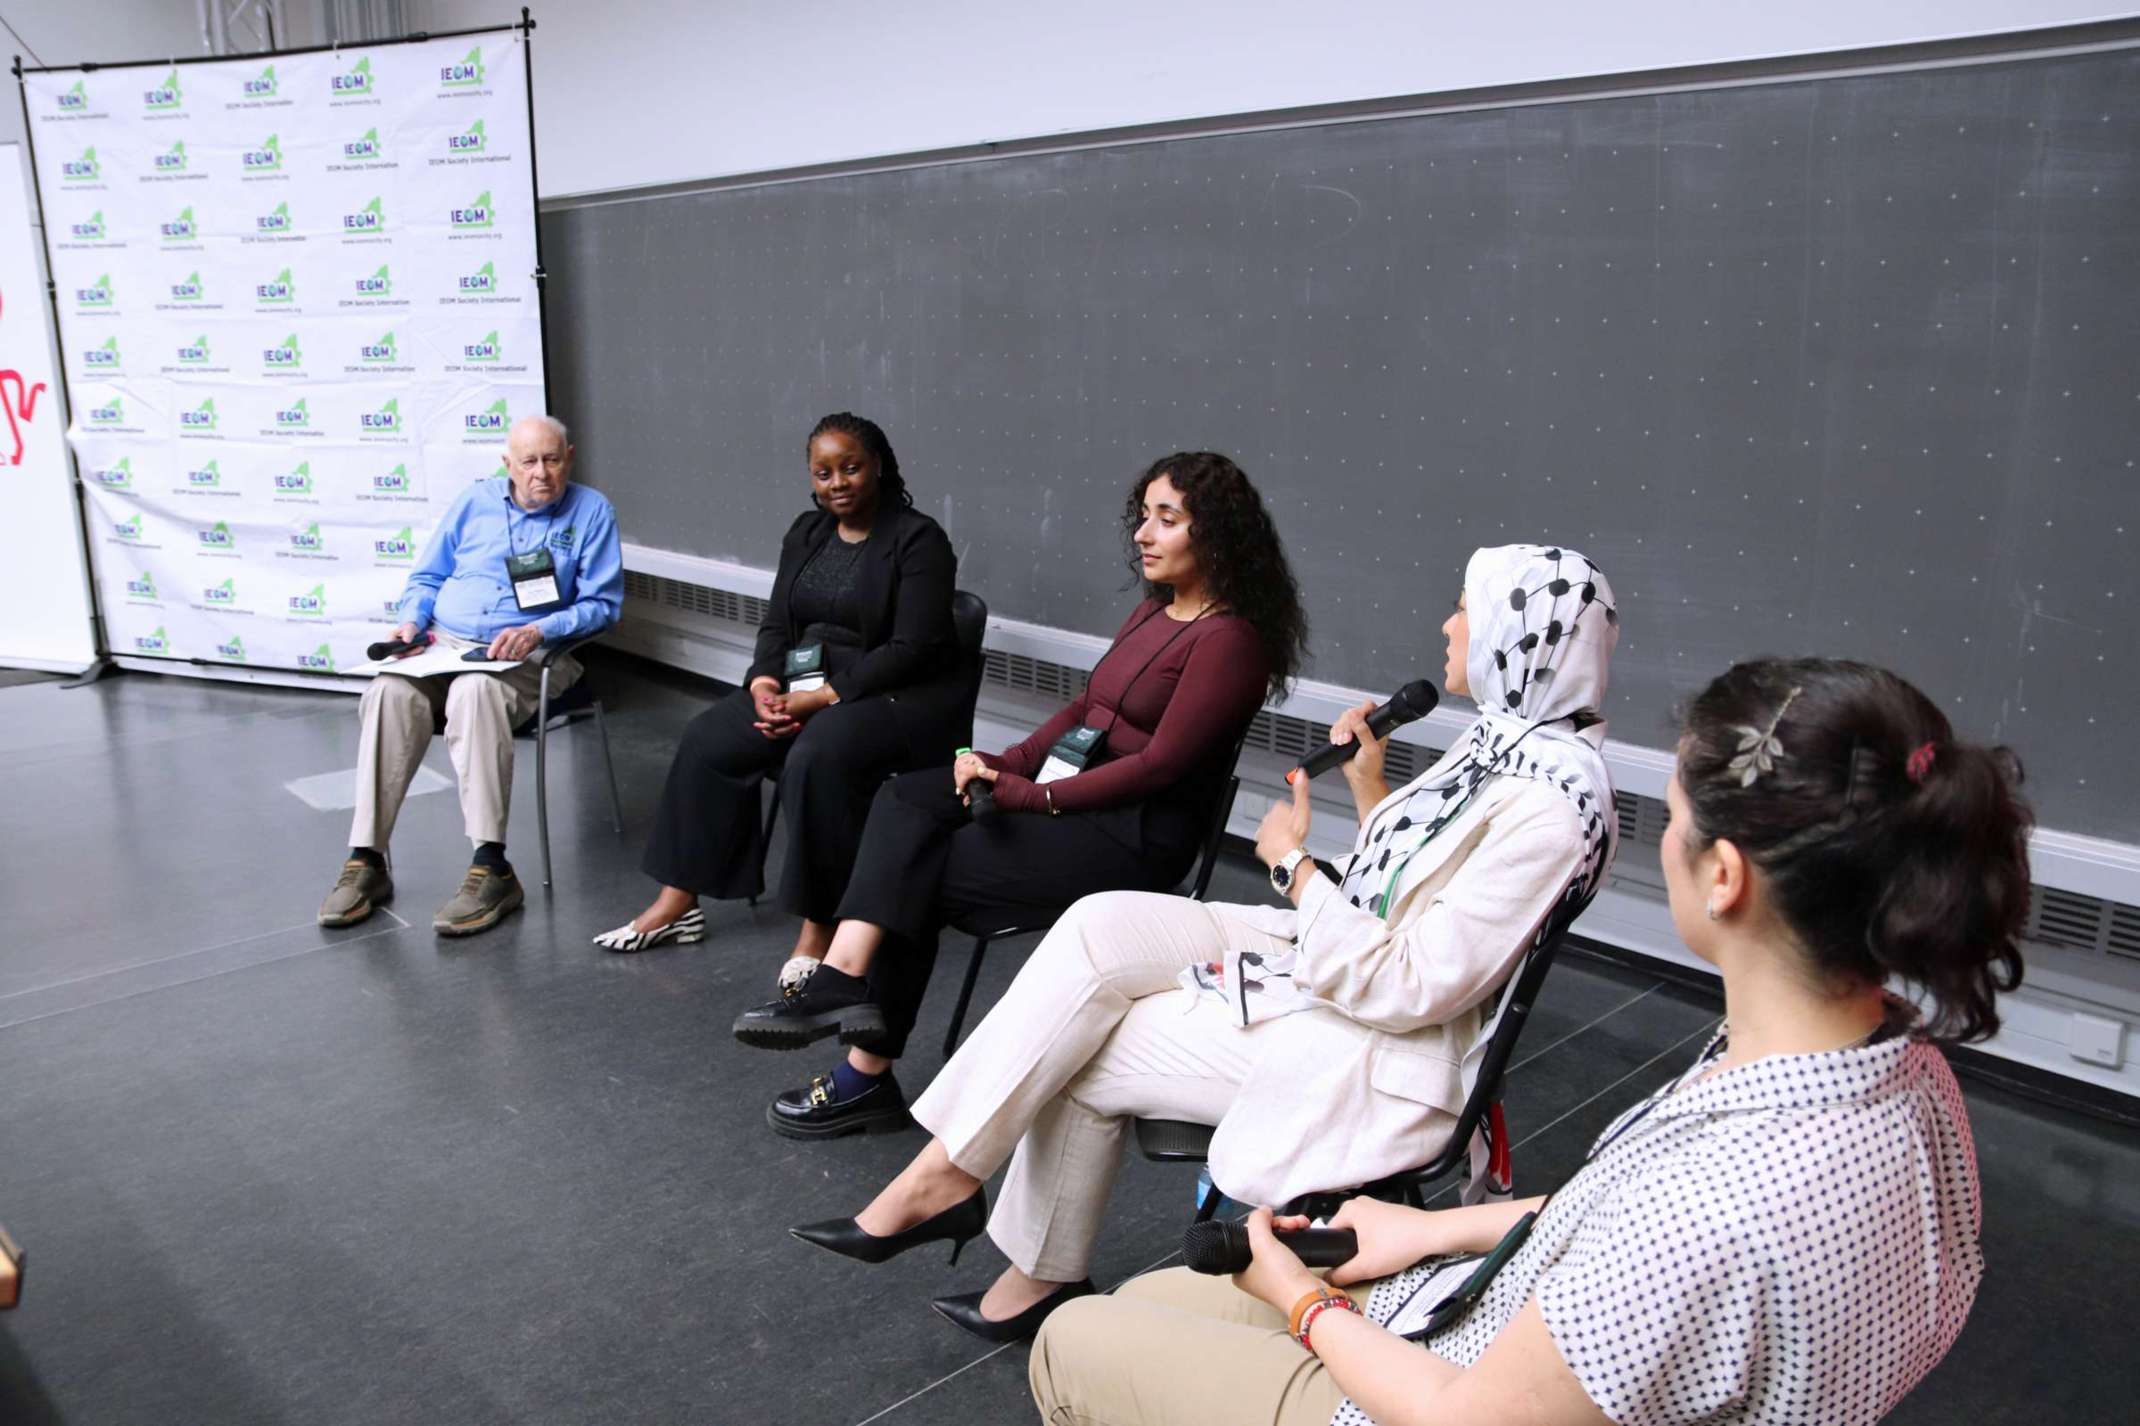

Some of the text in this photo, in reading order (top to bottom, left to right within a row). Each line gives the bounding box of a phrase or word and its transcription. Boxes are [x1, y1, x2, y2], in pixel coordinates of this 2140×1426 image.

[441, 66, 474, 80] IEOM
[331, 75, 364, 89] IEOM
[449, 136, 478, 148] IEOM
[344, 143, 372, 154] IEOM
[243, 152, 273, 165] IEOM
[471, 154, 511, 163] International
[344, 214, 375, 227] IEOM
[451, 209, 485, 223] IEOM
[356, 279, 384, 291] IEOM
[459, 277, 488, 288] IEOM
[257, 285, 286, 297] IEOM
[264, 349, 293, 361] IEOM
[362, 346, 388, 357] IEOM
[464, 345, 492, 356] IEOM
[361, 414, 392, 426] IEOM
[465, 415, 500, 427] IEOM
[275, 476, 304, 488] IEOM
[374, 476, 401, 487] IEOM
[375, 541, 406, 553] IEOM
[289, 597, 317, 608] IEOM
